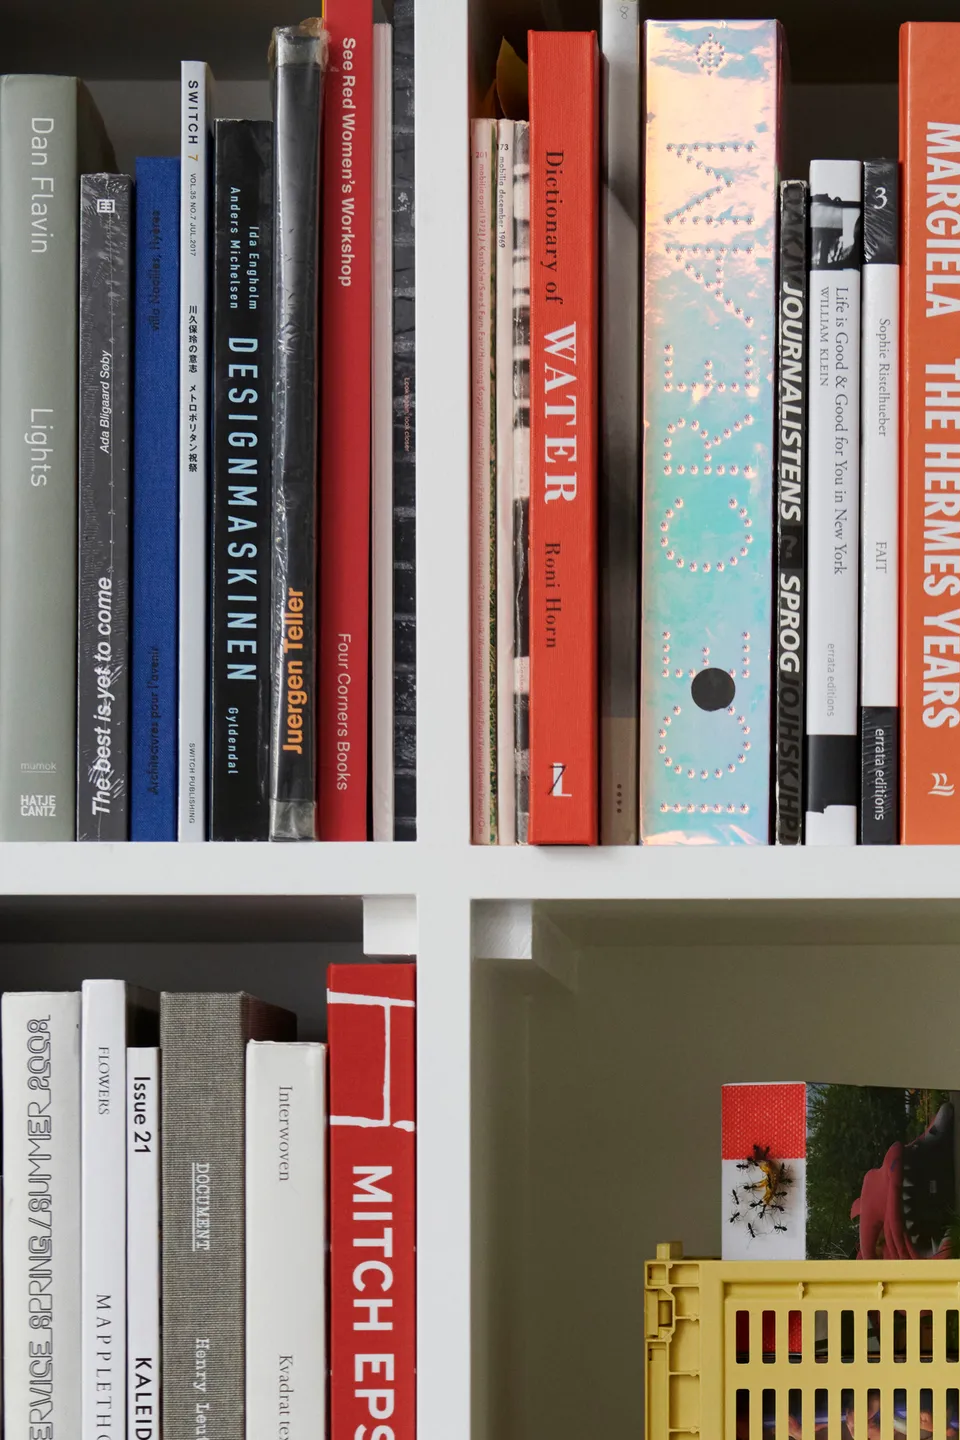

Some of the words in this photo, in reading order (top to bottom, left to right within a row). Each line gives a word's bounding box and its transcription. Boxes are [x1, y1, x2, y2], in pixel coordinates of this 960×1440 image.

[342, 38, 355, 70] See
[188, 80, 198, 144] SWITCH
[342, 75, 355, 108] Red
[31, 118, 54, 165] Dan
[188, 154, 198, 162] 7
[31, 178, 54, 253] Flavin
[230, 187, 239, 235] Anders
[540, 151, 564, 271] Dictionary
[248, 226, 259, 246] Ida
[338, 198, 354, 287] Workshop
[230, 240, 239, 309] Michelsen
[247, 251, 259, 310] Engholm
[545, 278, 563, 304] of
[831, 287, 849, 313] Life
[833, 317, 848, 327] is
[833, 332, 848, 369] Good
[876, 318, 890, 359] Sophie
[779, 281, 803, 522] JOURNALISTENS
[833, 376, 848, 387] &
[878, 364, 890, 436] Ristelhueber
[543, 321, 577, 505] WATER
[833, 393, 848, 431] Good
[24, 409, 53, 486] Lights
[833, 437, 848, 455] for
[832, 460, 848, 488] You
[832, 490, 847, 502] in
[228, 337, 258, 681] DESIGNMASKINEN
[832, 509, 847, 539] New
[544, 541, 561, 588] Roni
[832, 544, 848, 574] York
[875, 541, 887, 574] FAIT
[99, 578, 111, 635] come
[283, 587, 305, 653] Teller
[546, 597, 561, 648] Horn
[779, 574, 800, 673] SPROG
[93, 641, 112, 662] to
[338, 634, 351, 669] Four
[922, 608, 960, 728] YEARS
[94, 665, 115, 701] yet
[337, 676, 351, 736] Corners
[93, 704, 111, 722] is
[282, 661, 308, 755] Juergen
[93, 726, 111, 773] best
[225, 707, 238, 774] Gyldendal
[336, 741, 350, 790] Books
[20, 795, 56, 806] HATJE
[20, 806, 56, 817] CANTZ
[92, 776, 111, 816] The
[134, 1076, 151, 1125] Issue
[134, 1132, 151, 1154] 21
[279, 1085, 293, 1181] Interwoven
[28, 1101, 53, 1337] SPRING/SUMMER
[353, 1166, 394, 1330] MITCH
